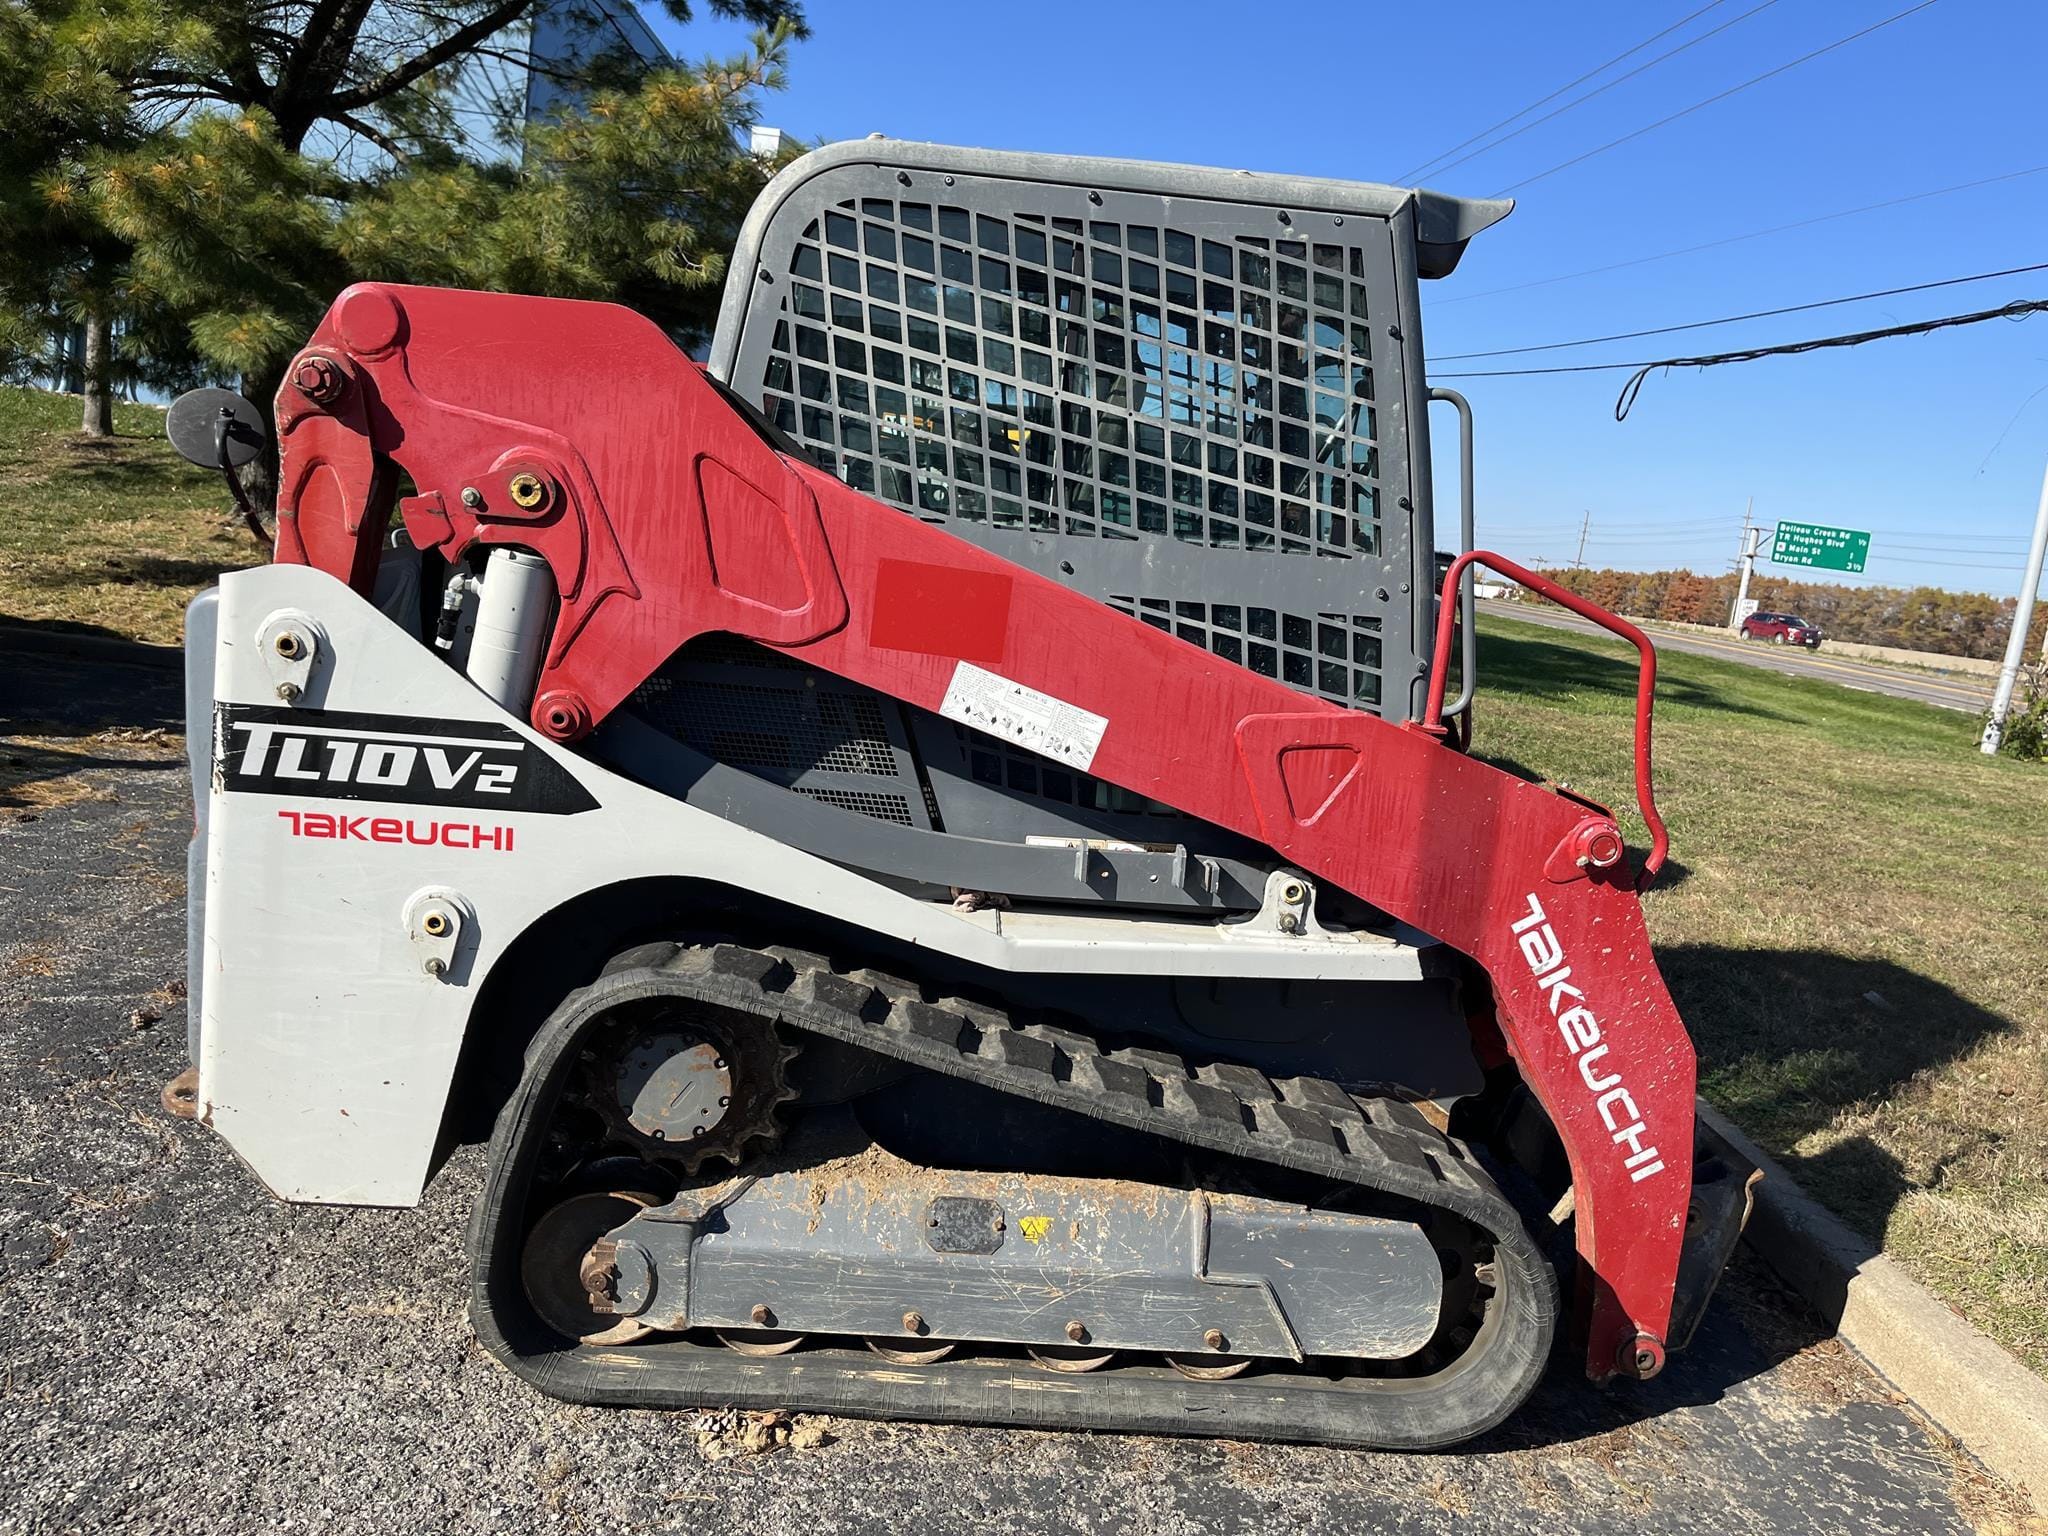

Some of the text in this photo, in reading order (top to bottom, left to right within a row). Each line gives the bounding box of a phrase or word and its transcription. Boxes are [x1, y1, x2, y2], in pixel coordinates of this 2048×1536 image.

[1780, 523, 1851, 540] Belleau Creek Rd
[1779, 532, 1845, 548] TR Hughes Blvd
[1788, 544, 1809, 554] Main
[1811, 547, 1821, 555] St
[1774, 552, 1813, 565] Bryan Rd
[232, 720, 526, 795] TL10V2
